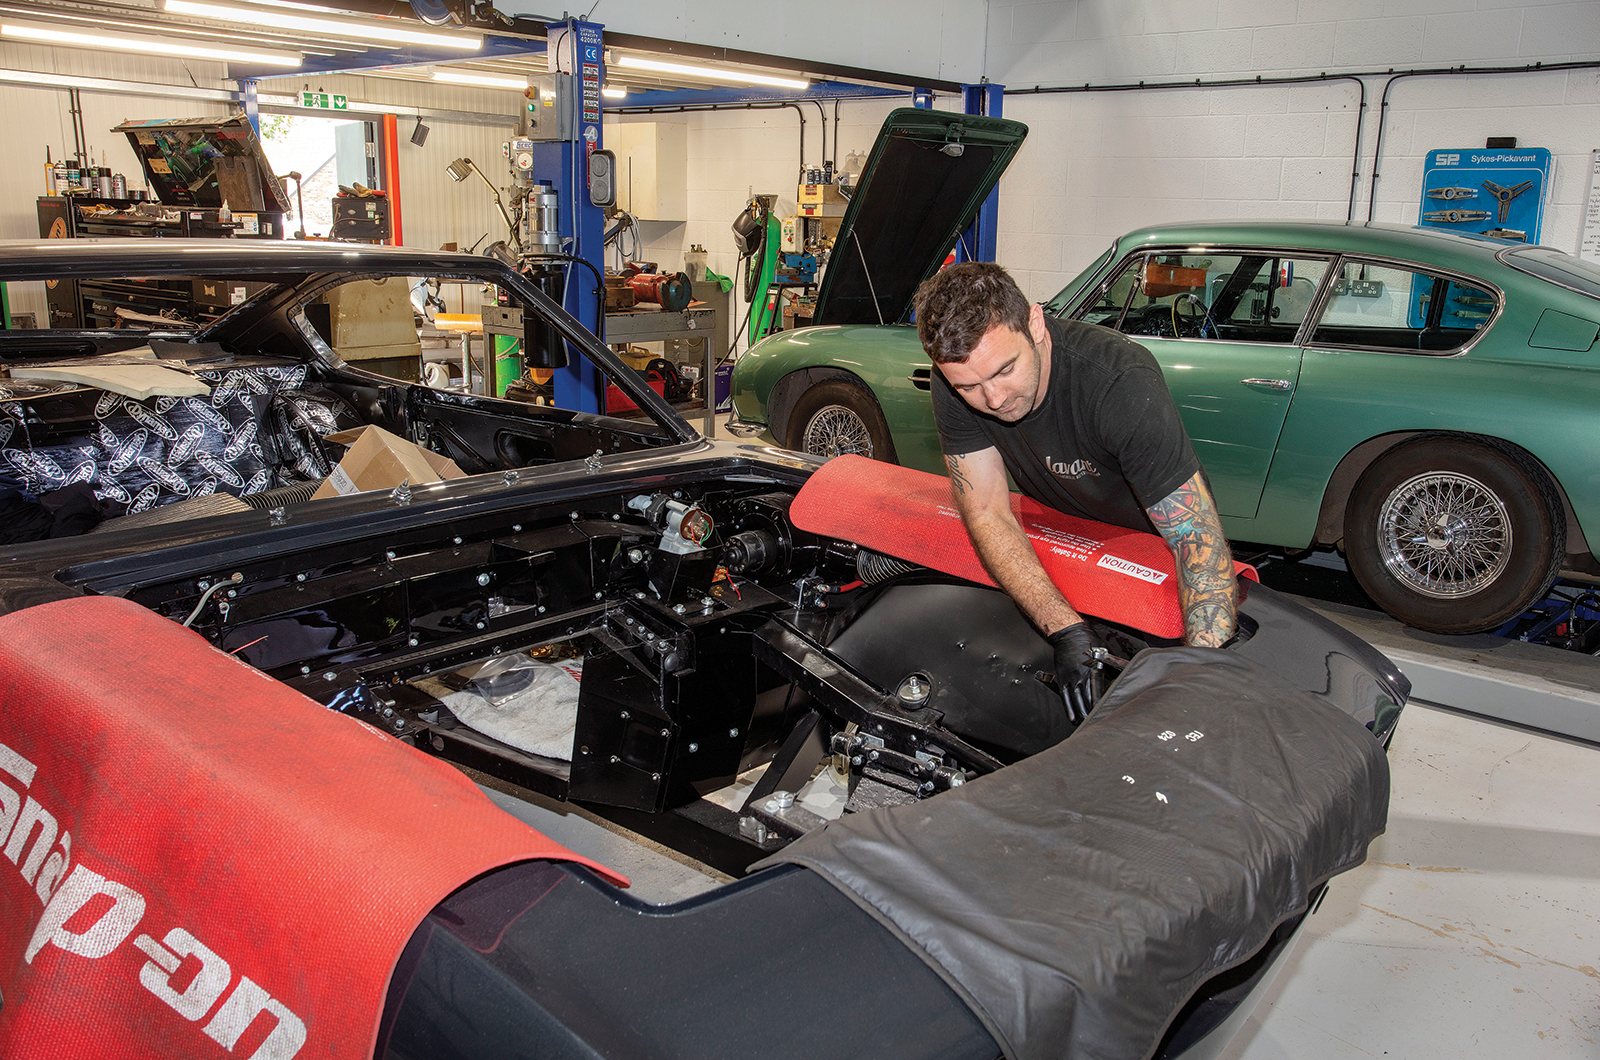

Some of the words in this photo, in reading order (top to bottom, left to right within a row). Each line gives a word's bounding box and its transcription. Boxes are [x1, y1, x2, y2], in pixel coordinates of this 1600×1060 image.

[1470, 154, 1537, 165] Sykes-Pickavant
[128, 404, 174, 438] Dynamat
[110, 433, 146, 473] Dynamat
[1049, 540, 1076, 549] approved
[1077, 554, 1088, 562] Do
[1101, 556, 1152, 578] CAUTION
